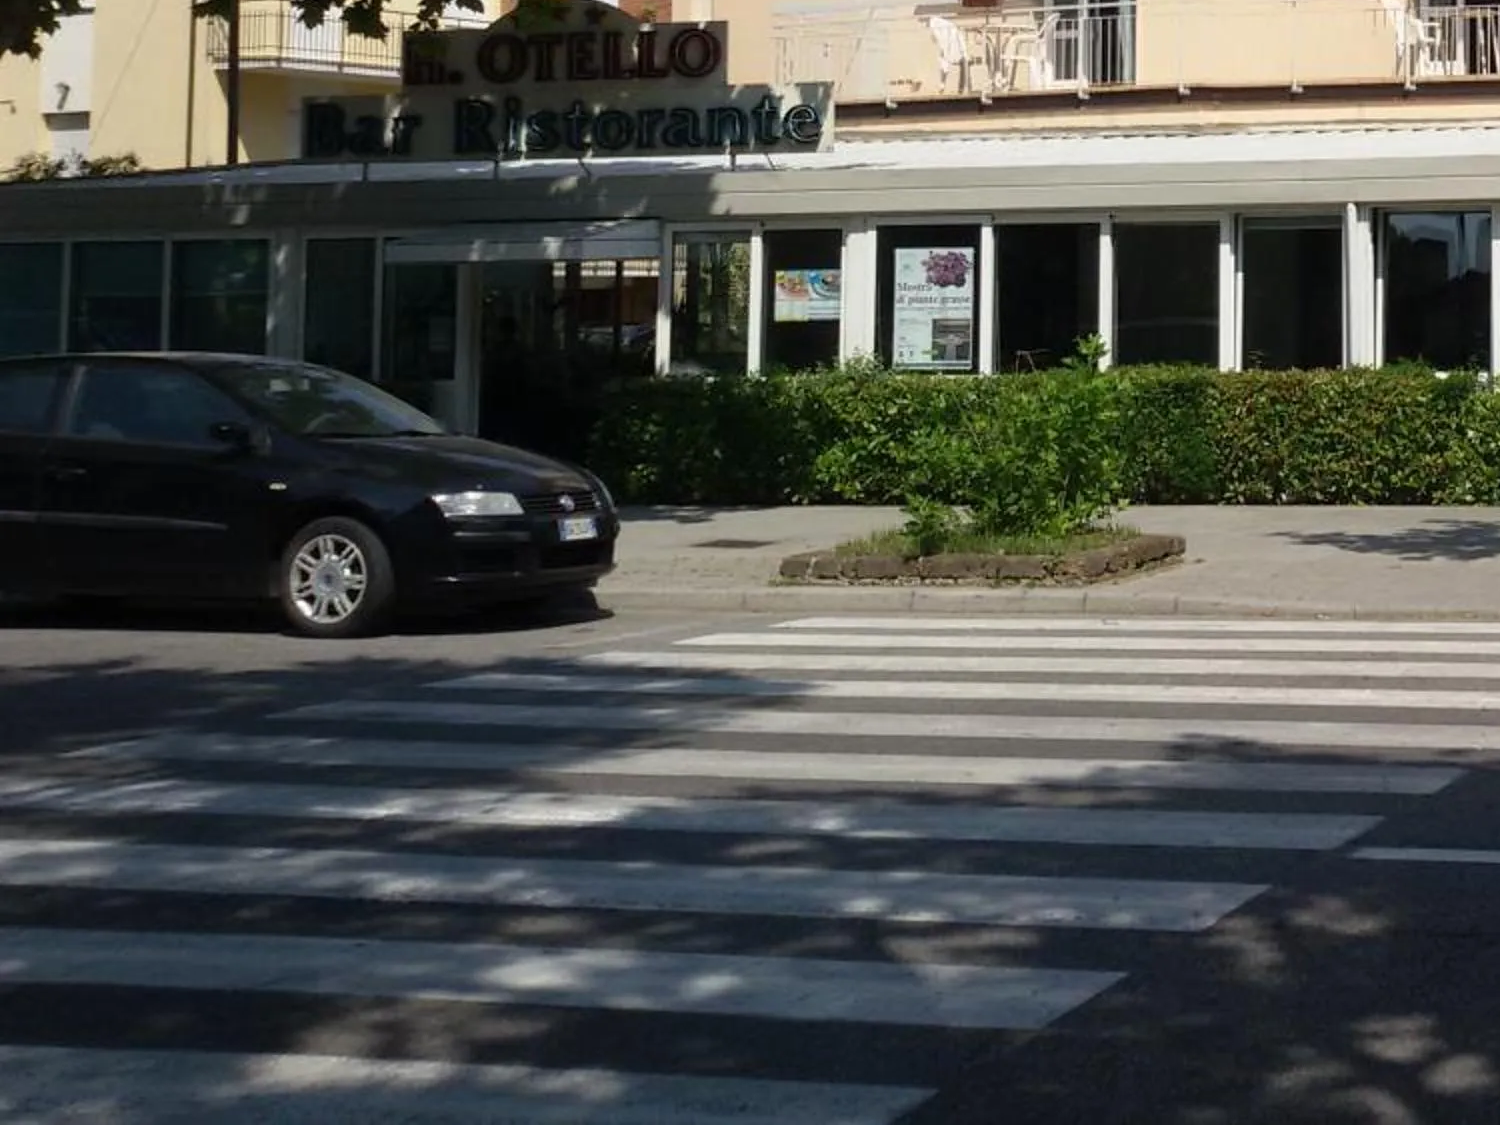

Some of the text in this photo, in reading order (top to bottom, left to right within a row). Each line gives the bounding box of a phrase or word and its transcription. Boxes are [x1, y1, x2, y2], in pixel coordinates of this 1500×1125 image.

[476, 27, 722, 82] OTELLO
[304, 94, 821, 157] Bar Ristorante
